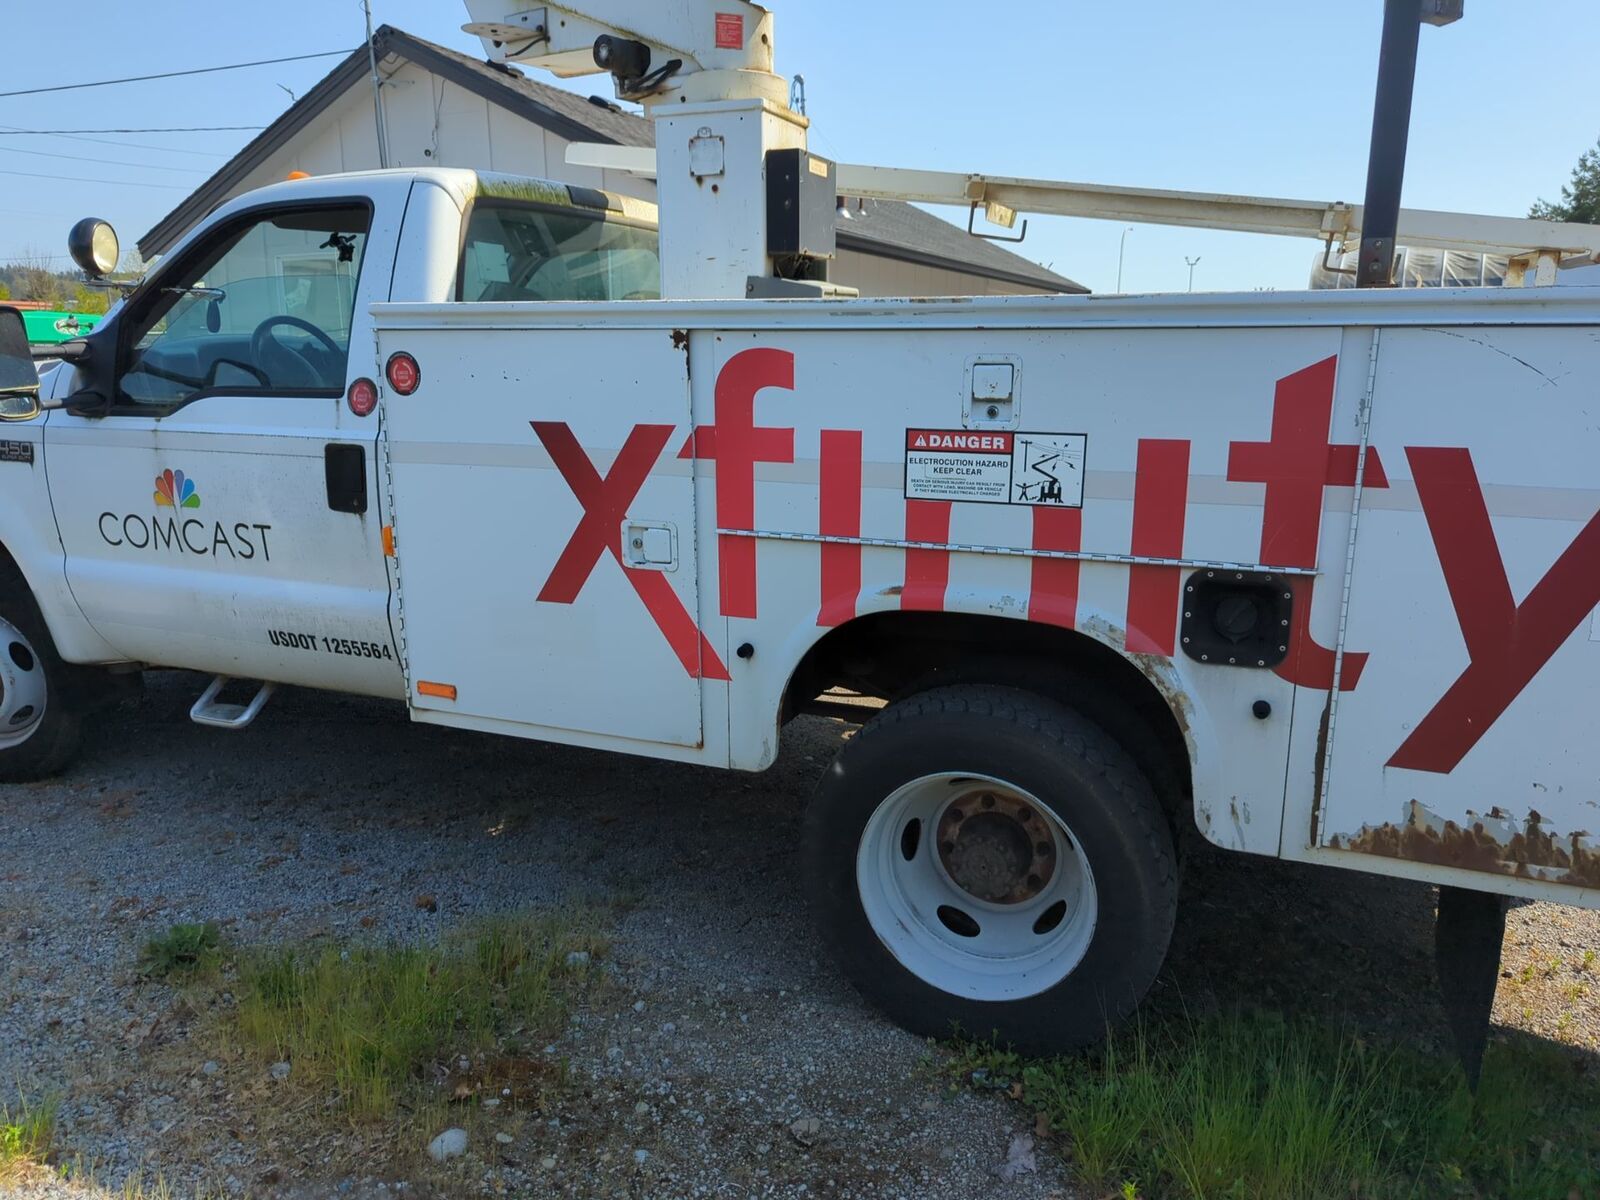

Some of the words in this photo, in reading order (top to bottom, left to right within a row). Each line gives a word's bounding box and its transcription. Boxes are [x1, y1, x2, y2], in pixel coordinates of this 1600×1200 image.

[929, 434, 1005, 449] DANGER
[909, 457, 974, 466] ELECTROCUTION
[975, 460, 1009, 468] HAZARD
[955, 468, 982, 476] CLEAR
[98, 511, 272, 562] COMCAST
[529, 347, 1600, 774] xfinity
[268, 629, 318, 651] USDOT
[322, 636, 392, 661] 1255564
